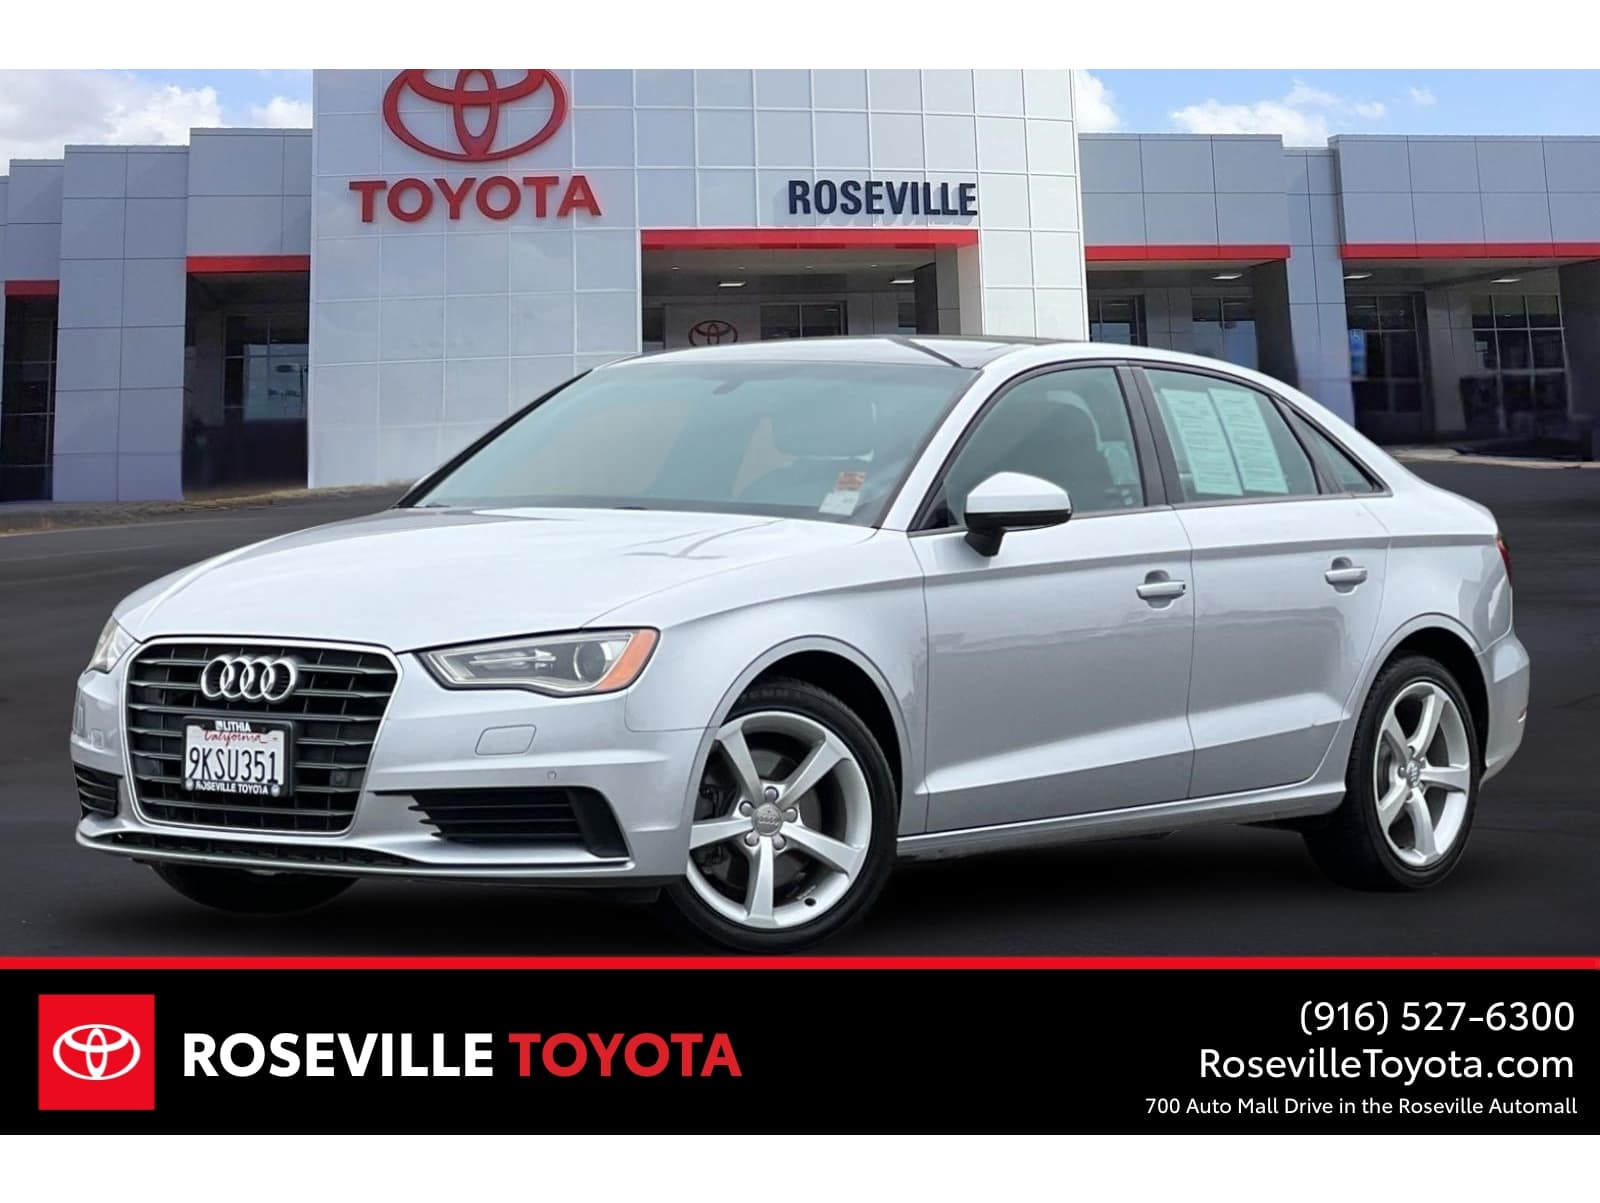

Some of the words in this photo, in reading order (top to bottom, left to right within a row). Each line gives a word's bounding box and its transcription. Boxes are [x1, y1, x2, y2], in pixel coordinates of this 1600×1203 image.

[349, 175, 602, 223] TOYOTA
[788, 179, 978, 217] ROSEVILLE
[223, 721, 252, 732] LITHIA
[188, 747, 279, 784] 9KSU351
[238, 784, 269, 795] TOYOTA
